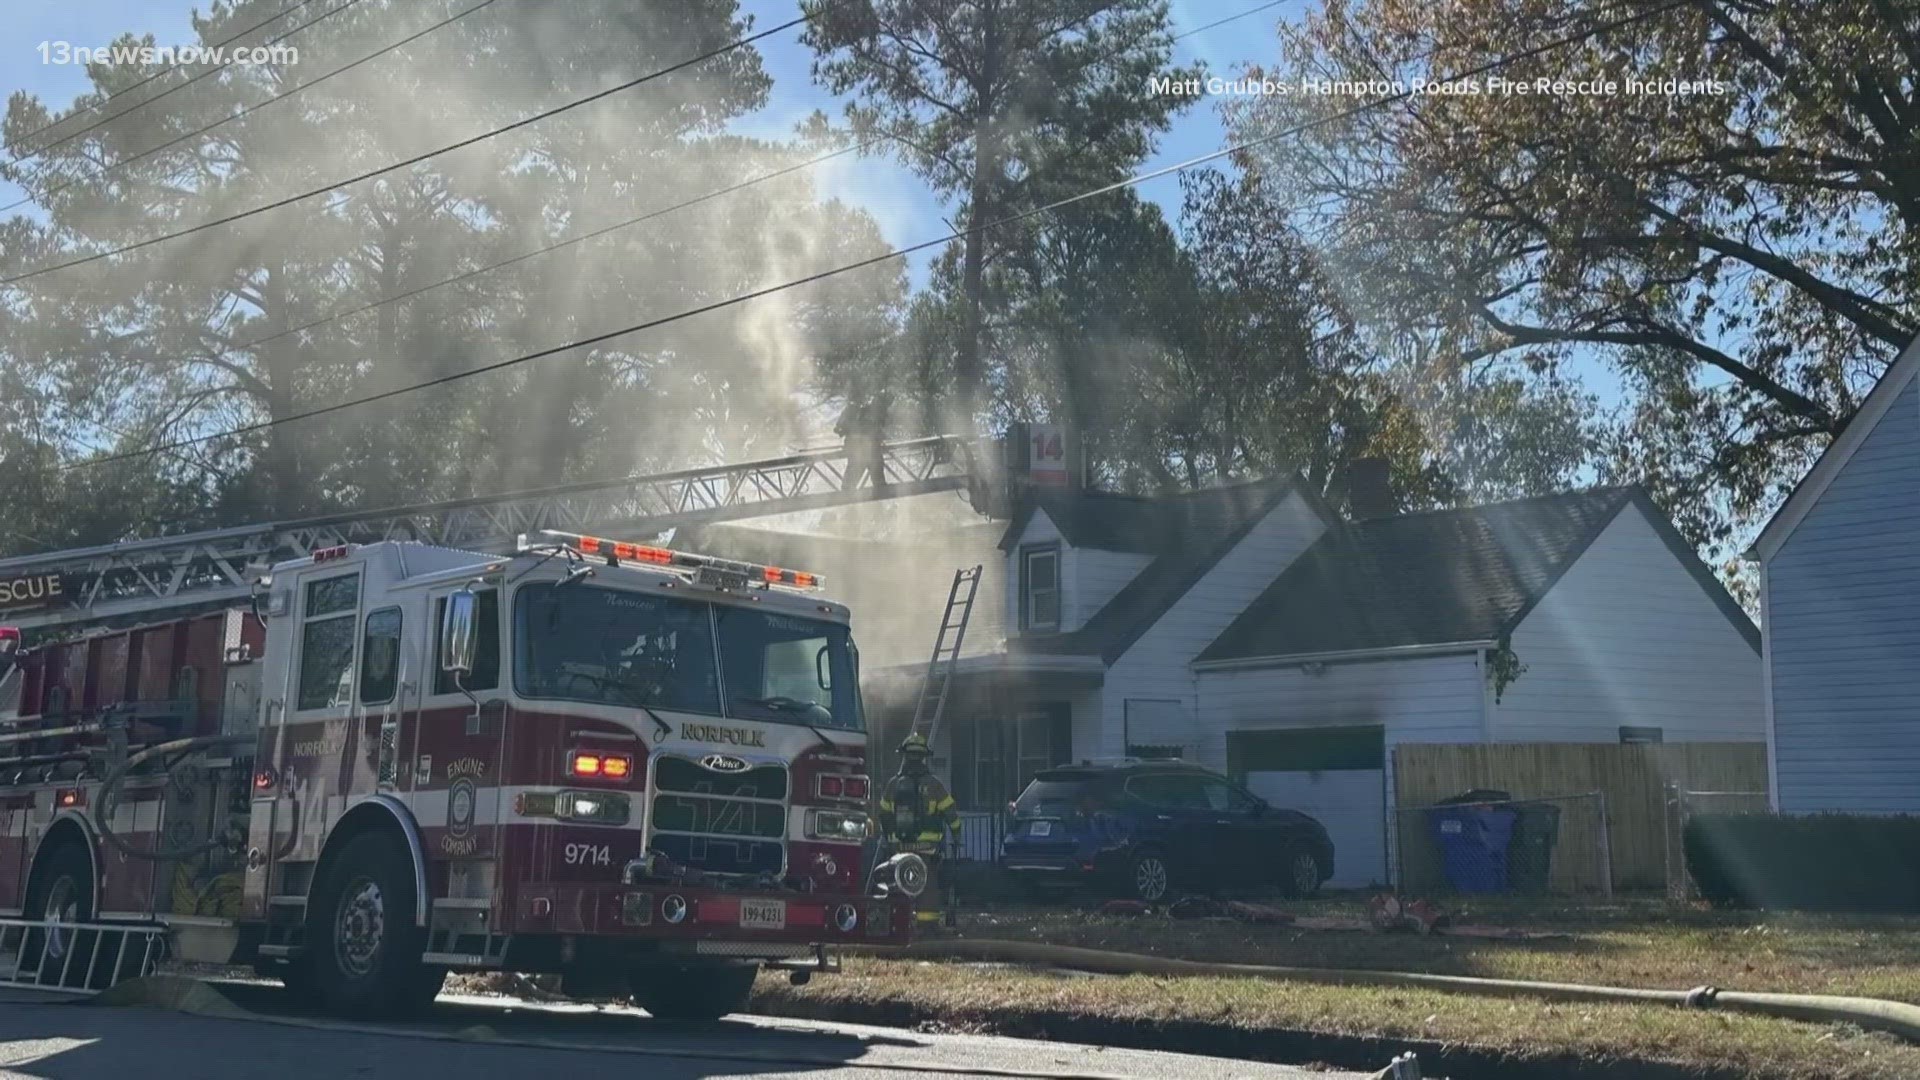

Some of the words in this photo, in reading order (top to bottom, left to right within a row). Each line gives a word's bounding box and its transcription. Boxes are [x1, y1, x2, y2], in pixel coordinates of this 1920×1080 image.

[1032, 432, 1064, 461] 14
[681, 722, 765, 748] NORFOLK
[294, 741, 343, 757] NORFOLK
[447, 756, 486, 780] ENGINE
[708, 754, 741, 769] Pierce
[676, 781, 764, 863] 14
[440, 834, 477, 856] COMPANY
[565, 842, 611, 866] 9714
